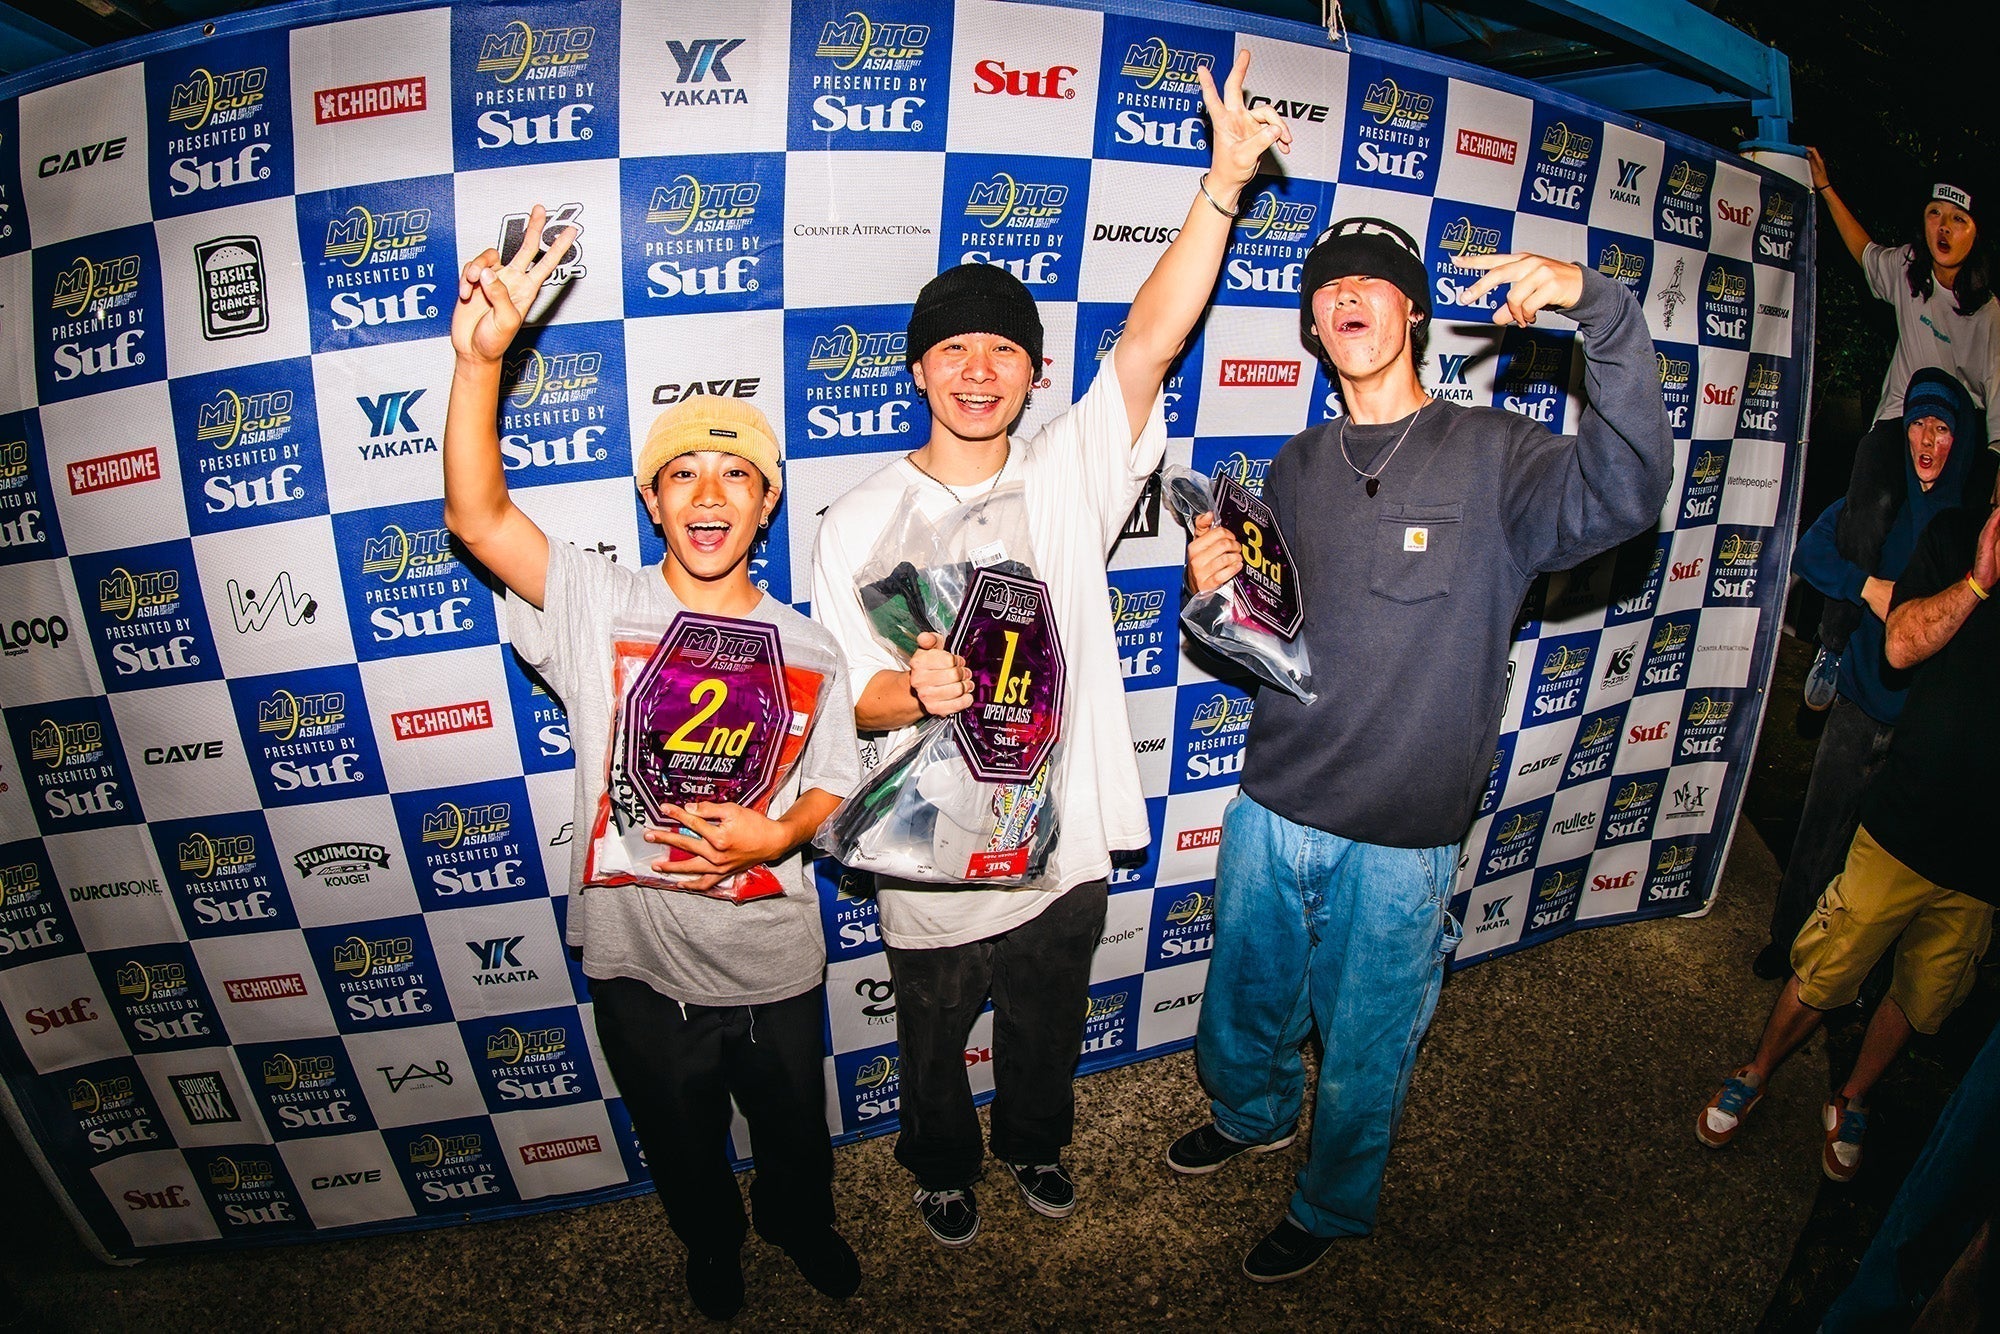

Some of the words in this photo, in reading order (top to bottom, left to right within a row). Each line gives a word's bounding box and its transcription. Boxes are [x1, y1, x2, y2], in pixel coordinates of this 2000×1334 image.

[480, 25, 595, 59] MOTO
[821, 20, 930, 46] MOTO
[529, 52, 588, 66] CUP
[868, 46, 923, 59] CUP
[526, 64, 558, 80] ASIA
[863, 58, 893, 70] ASIA
[171, 67, 267, 109] MOTO
[814, 75, 901, 91] PRESENTED
[910, 77, 926, 91] BY
[213, 93, 263, 110] CUP
[338, 80, 423, 116] CHROME
[476, 85, 567, 106] PRESENTED
[576, 82, 594, 97] BY
[661, 88, 748, 107] YAKATA
[210, 109, 237, 125] ASIA
[169, 125, 248, 155] PRESENTED
[254, 123, 270, 137] BY
[1359, 125, 1415, 145] PRESENTED
[1418, 135, 1429, 148] BY
[38, 137, 127, 179] CAVE
[1469, 139, 1515, 161] CHROME
[1537, 163, 1575, 181] PRESENTED
[1578, 172, 1587, 183] BY
[649, 183, 761, 210] MOTO
[1609, 189, 1641, 206] YAKATA
[1938, 187, 1965, 204] silent
[700, 207, 755, 219] CUP
[694, 220, 725, 232] ASIA
[794, 224, 849, 236] COUNTER
[852, 224, 922, 235] ATTRACTION
[646, 238, 732, 256] PRESENTED
[743, 236, 759, 250] BY
[210, 266, 254, 286] BASHI
[210, 281, 259, 299] BURGER
[212, 295, 256, 311] CHANCE
[1237, 365, 1298, 382] CHROME
[198, 390, 293, 427] MOTO
[241, 415, 291, 431] CUP
[239, 430, 266, 445] ASIA
[200, 447, 277, 473] PRESENTED
[284, 444, 299, 458] BY
[358, 438, 438, 460] YAKATA
[85, 452, 156, 486] CHROME
[1242, 521, 1281, 585] 3rd
[1246, 565, 1262, 582] OPEN
[985, 585, 1038, 611] MOTO
[1006, 614, 1021, 623] ASIA
[1009, 607, 1036, 616] CUP
[684, 632, 762, 656] MOTO
[711, 661, 734, 671] ASIA
[717, 654, 755, 663] CUP
[994, 630, 1031, 706] 1st
[1537, 678, 1574, 693] PRESENTED
[1575, 677, 1583, 685] BY
[259, 692, 344, 722] MOTO
[983, 704, 1005, 720] OPEN
[1006, 707, 1032, 724] CLASS
[299, 714, 344, 725] CUP
[414, 705, 489, 734] CHROME
[663, 679, 755, 756] 2nd
[299, 725, 322, 738] ASIA
[144, 741, 223, 765] CAVE
[264, 740, 335, 758] PRESENTED
[341, 738, 355, 748] BY
[669, 754, 698, 770] OPEN
[698, 756, 736, 772] CLASS
[1518, 754, 1562, 776] CAVE
[424, 803, 510, 833] MOTO
[1552, 812, 1596, 835] mullet
[464, 823, 510, 835] CUP
[463, 834, 487, 846] ASIA
[298, 845, 384, 869] FUJIMOTO
[428, 847, 497, 866] PRESENTED
[505, 845, 519, 856] BY
[324, 874, 369, 888] KOUGEI
[1475, 918, 1510, 934] YAKATA
[372, 964, 394, 975] ASIA
[373, 956, 413, 966] CUP
[341, 976, 405, 992] PRESENTED
[410, 974, 424, 984] BY
[473, 970, 538, 986] YAKATA
[243, 977, 301, 999] CHROME
[1154, 992, 1203, 1013] CAV
[178, 1076, 219, 1095] SOURCE
[271, 1090, 330, 1104] PRESENTED
[334, 1089, 346, 1098] BY
[186, 1092, 231, 1121] BMX
[538, 1139, 597, 1162] CHROME
[312, 1170, 381, 1189] CAVE
